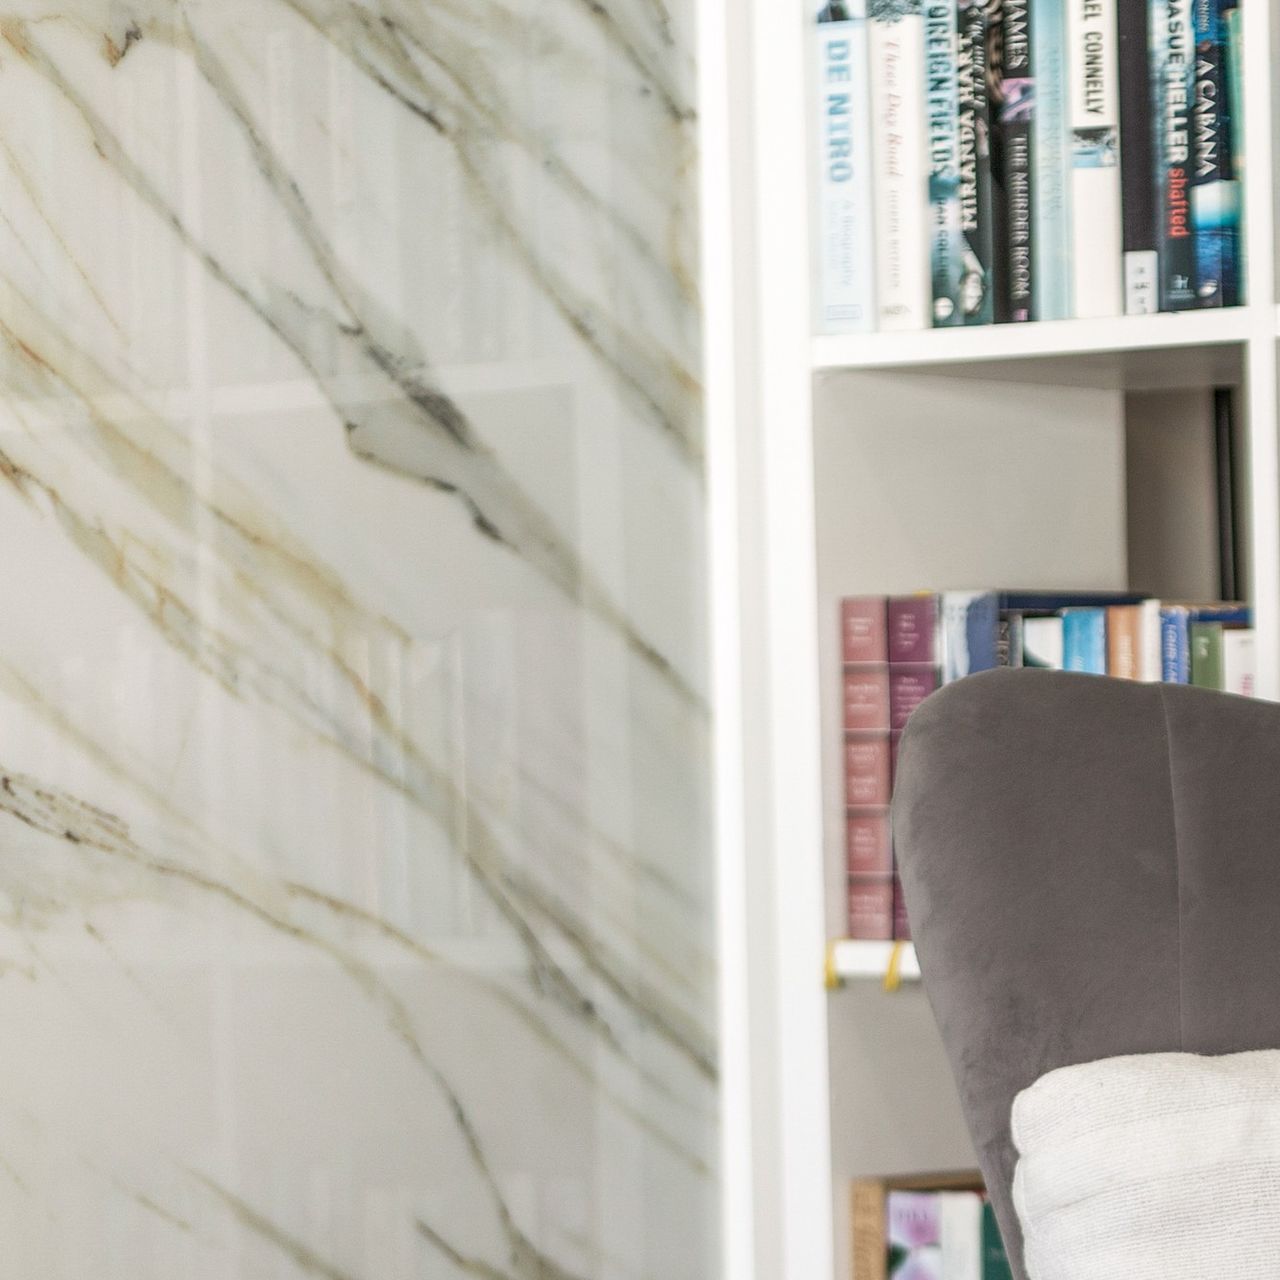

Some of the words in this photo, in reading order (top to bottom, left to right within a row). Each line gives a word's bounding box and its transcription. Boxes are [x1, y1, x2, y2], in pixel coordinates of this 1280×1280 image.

[827, 40, 853, 83] DE
[928, 0, 954, 91] OREIGN
[959, 32, 975, 102] HART
[1084, 31, 1104, 115] CONNELLY
[1196, 60, 1216, 77] A
[827, 93, 856, 184] NIRO
[929, 98, 955, 177] FIELDS
[1010, 134, 1029, 167] THE
[1166, 71, 1188, 162] HELLER
[1195, 79, 1218, 177] CABANA
[959, 109, 977, 231] MIRANDA
[1167, 168, 1191, 238] shafted
[1009, 172, 1030, 244] MURDER
[1010, 247, 1031, 300] ROOM
